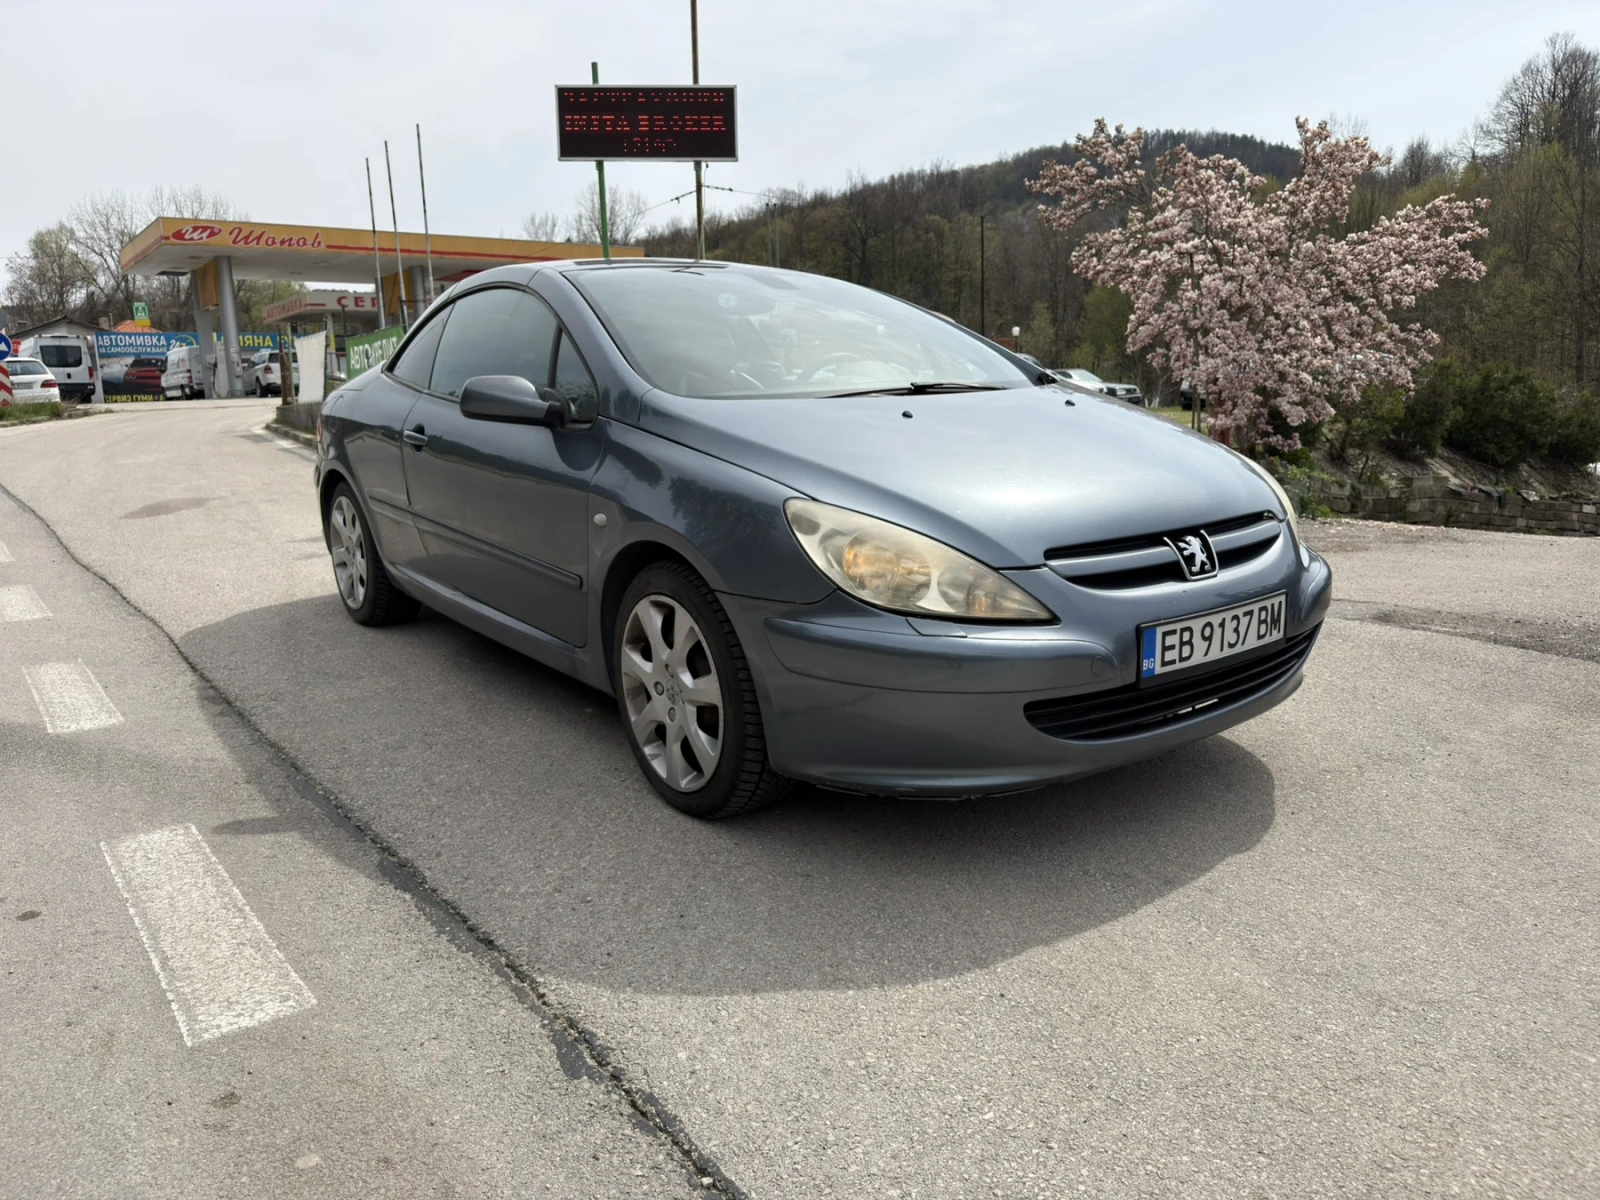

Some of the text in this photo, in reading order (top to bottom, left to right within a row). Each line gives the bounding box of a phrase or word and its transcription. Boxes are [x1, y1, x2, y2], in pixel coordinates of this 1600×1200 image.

[98, 335, 167, 346] АВТОМИВКА
[1160, 600, 1283, 668] EB 9137 BM
[1142, 658, 1155, 671] BG
